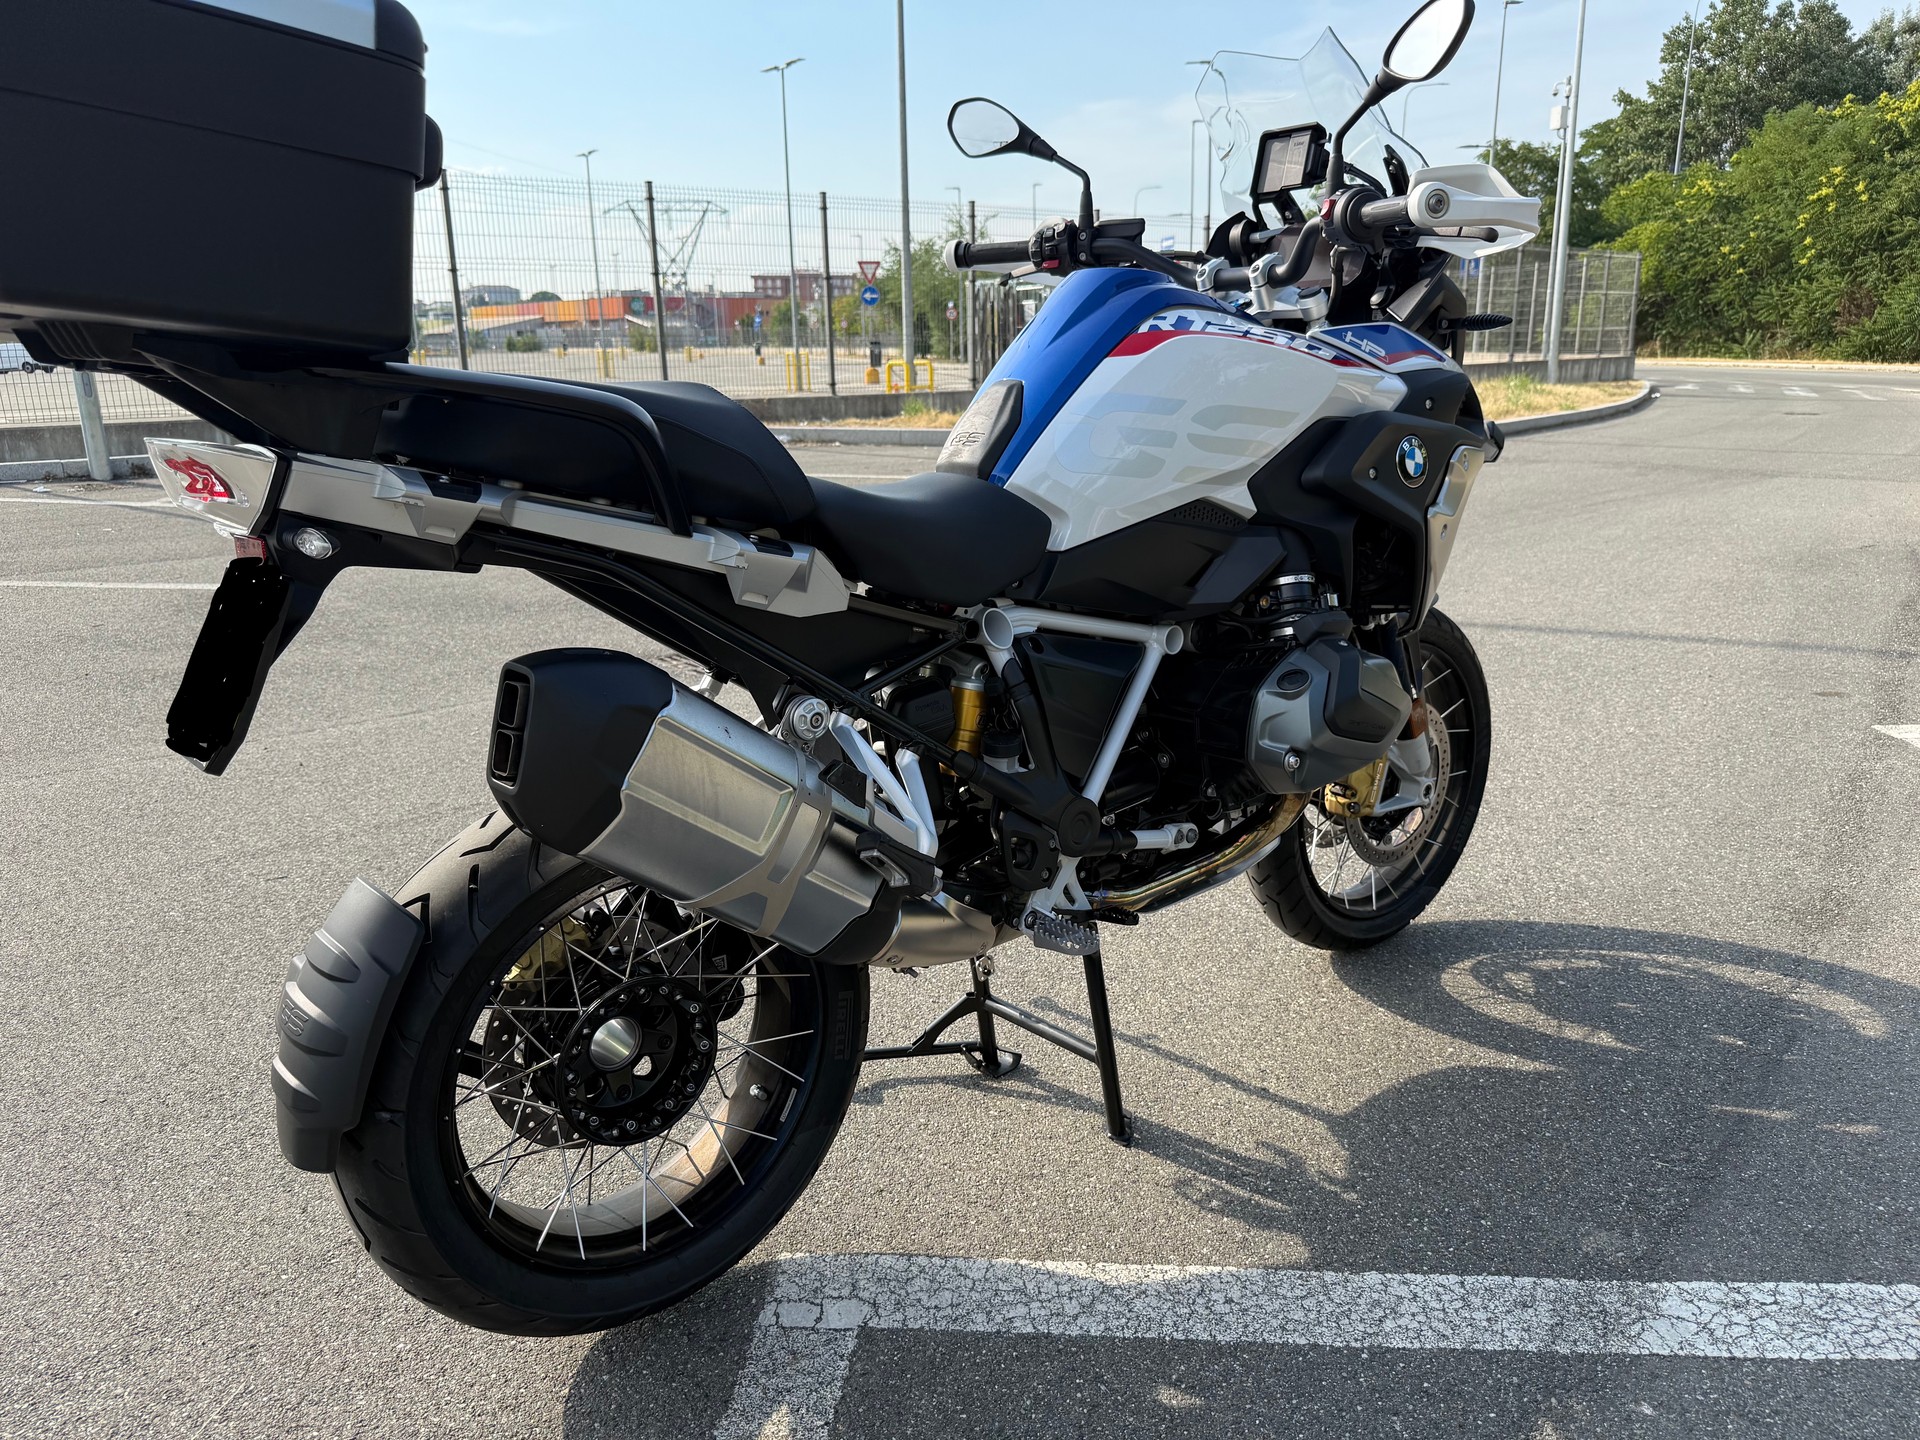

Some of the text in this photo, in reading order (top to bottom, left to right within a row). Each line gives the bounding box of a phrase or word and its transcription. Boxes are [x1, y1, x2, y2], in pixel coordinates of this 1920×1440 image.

[1343, 330, 1388, 359] HP
[1402, 438, 1428, 458] BMW
[281, 998, 310, 1037] GS
[834, 989, 855, 1061] PIRELLI
